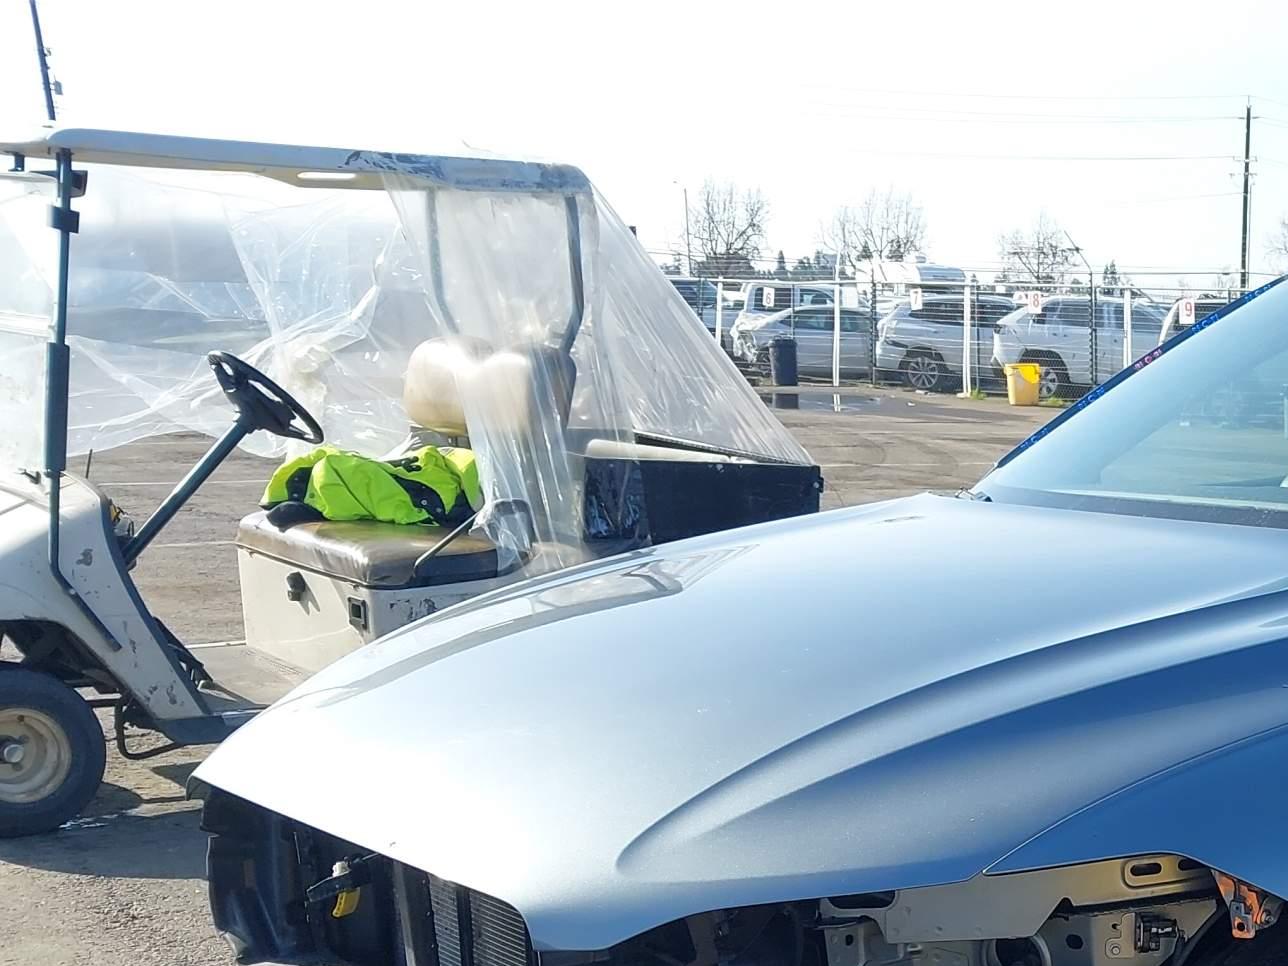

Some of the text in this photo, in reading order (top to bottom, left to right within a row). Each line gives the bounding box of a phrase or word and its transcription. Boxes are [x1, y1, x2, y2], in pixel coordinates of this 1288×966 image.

[765, 292, 772, 305] 6
[1032, 293, 1040, 308] 8
[1184, 301, 1193, 317] 9
